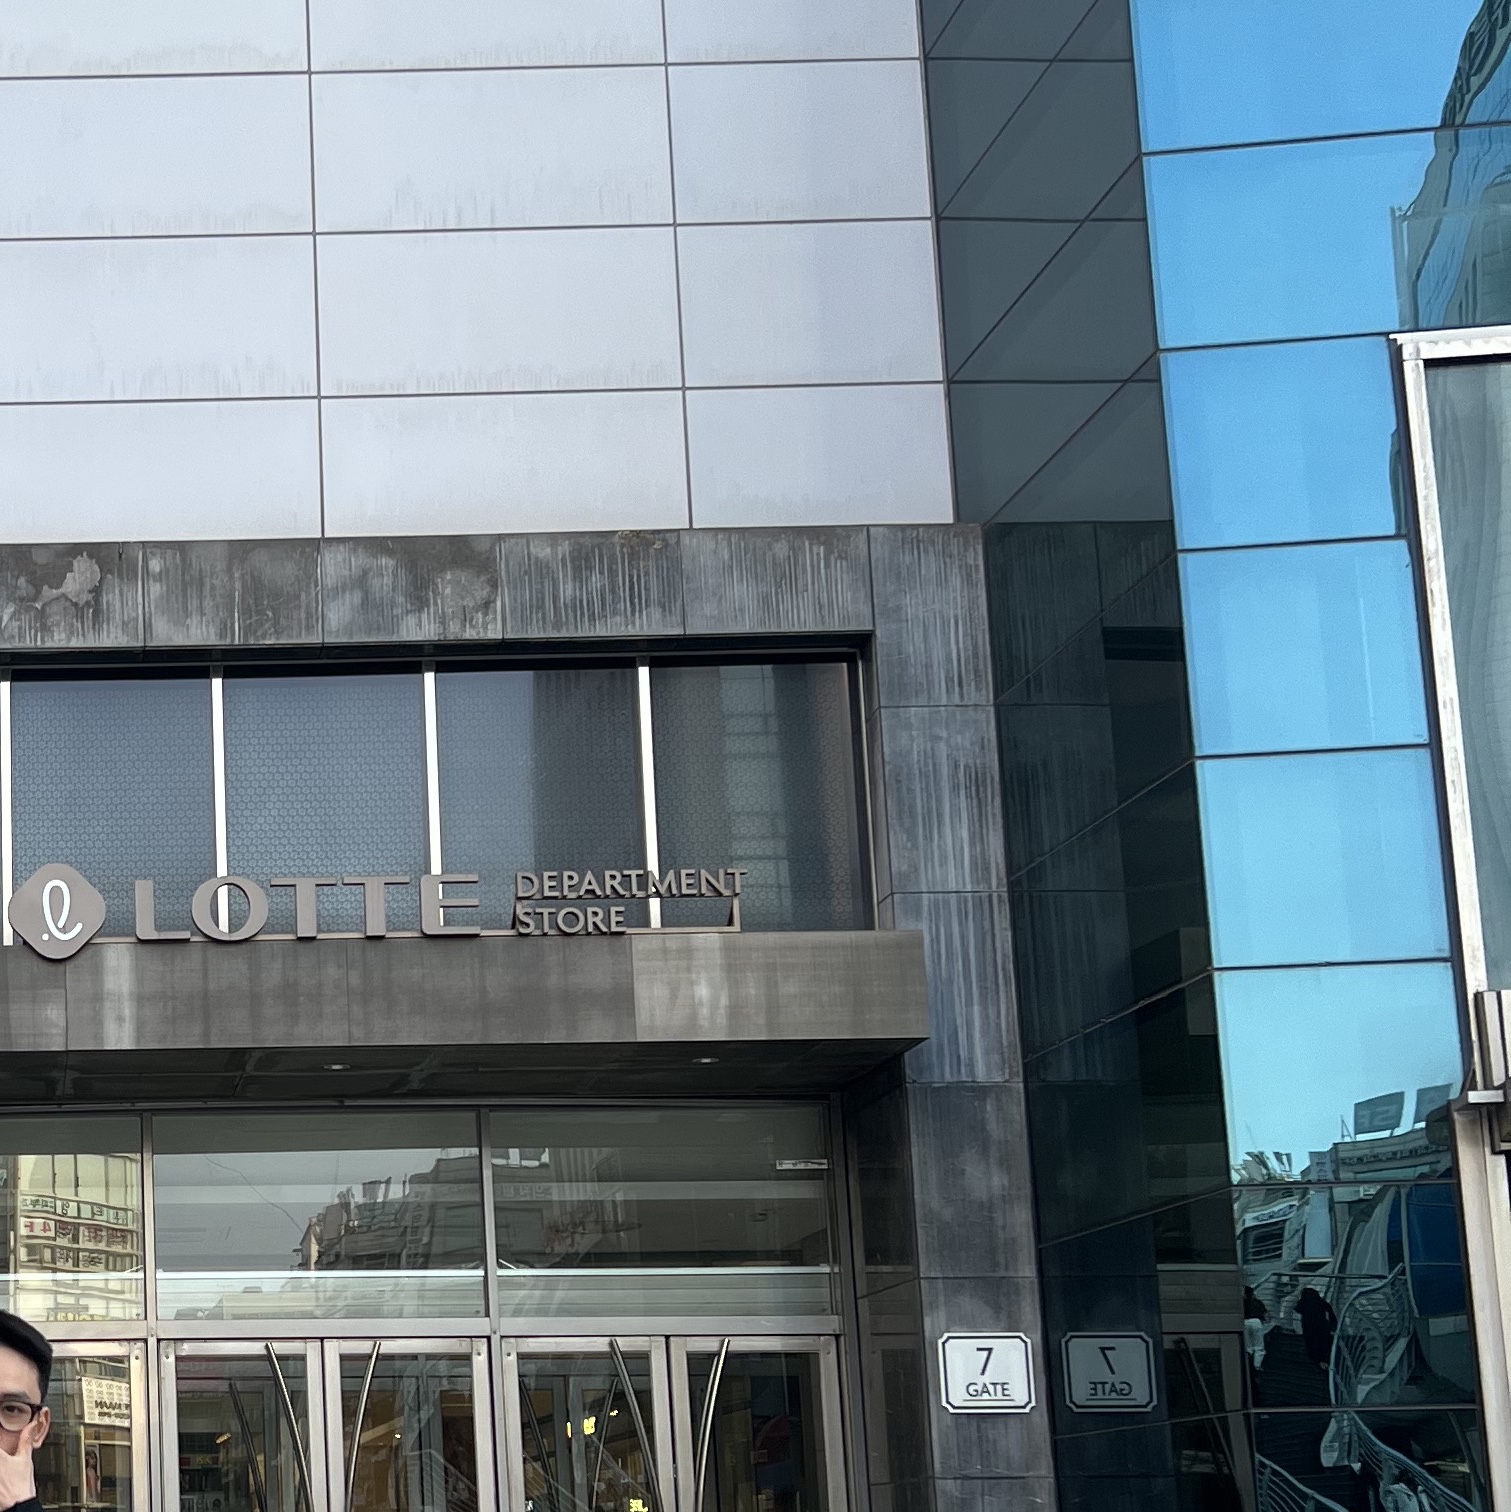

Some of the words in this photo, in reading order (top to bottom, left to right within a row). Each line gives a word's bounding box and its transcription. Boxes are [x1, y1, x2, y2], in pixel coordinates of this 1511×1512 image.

[516, 869, 748, 898] DEPARTMENT
[135, 874, 481, 941] LOTTE
[516, 906, 628, 934] STORE
[976, 1347, 993, 1376] 7
[966, 1382, 1011, 1397] GATE
